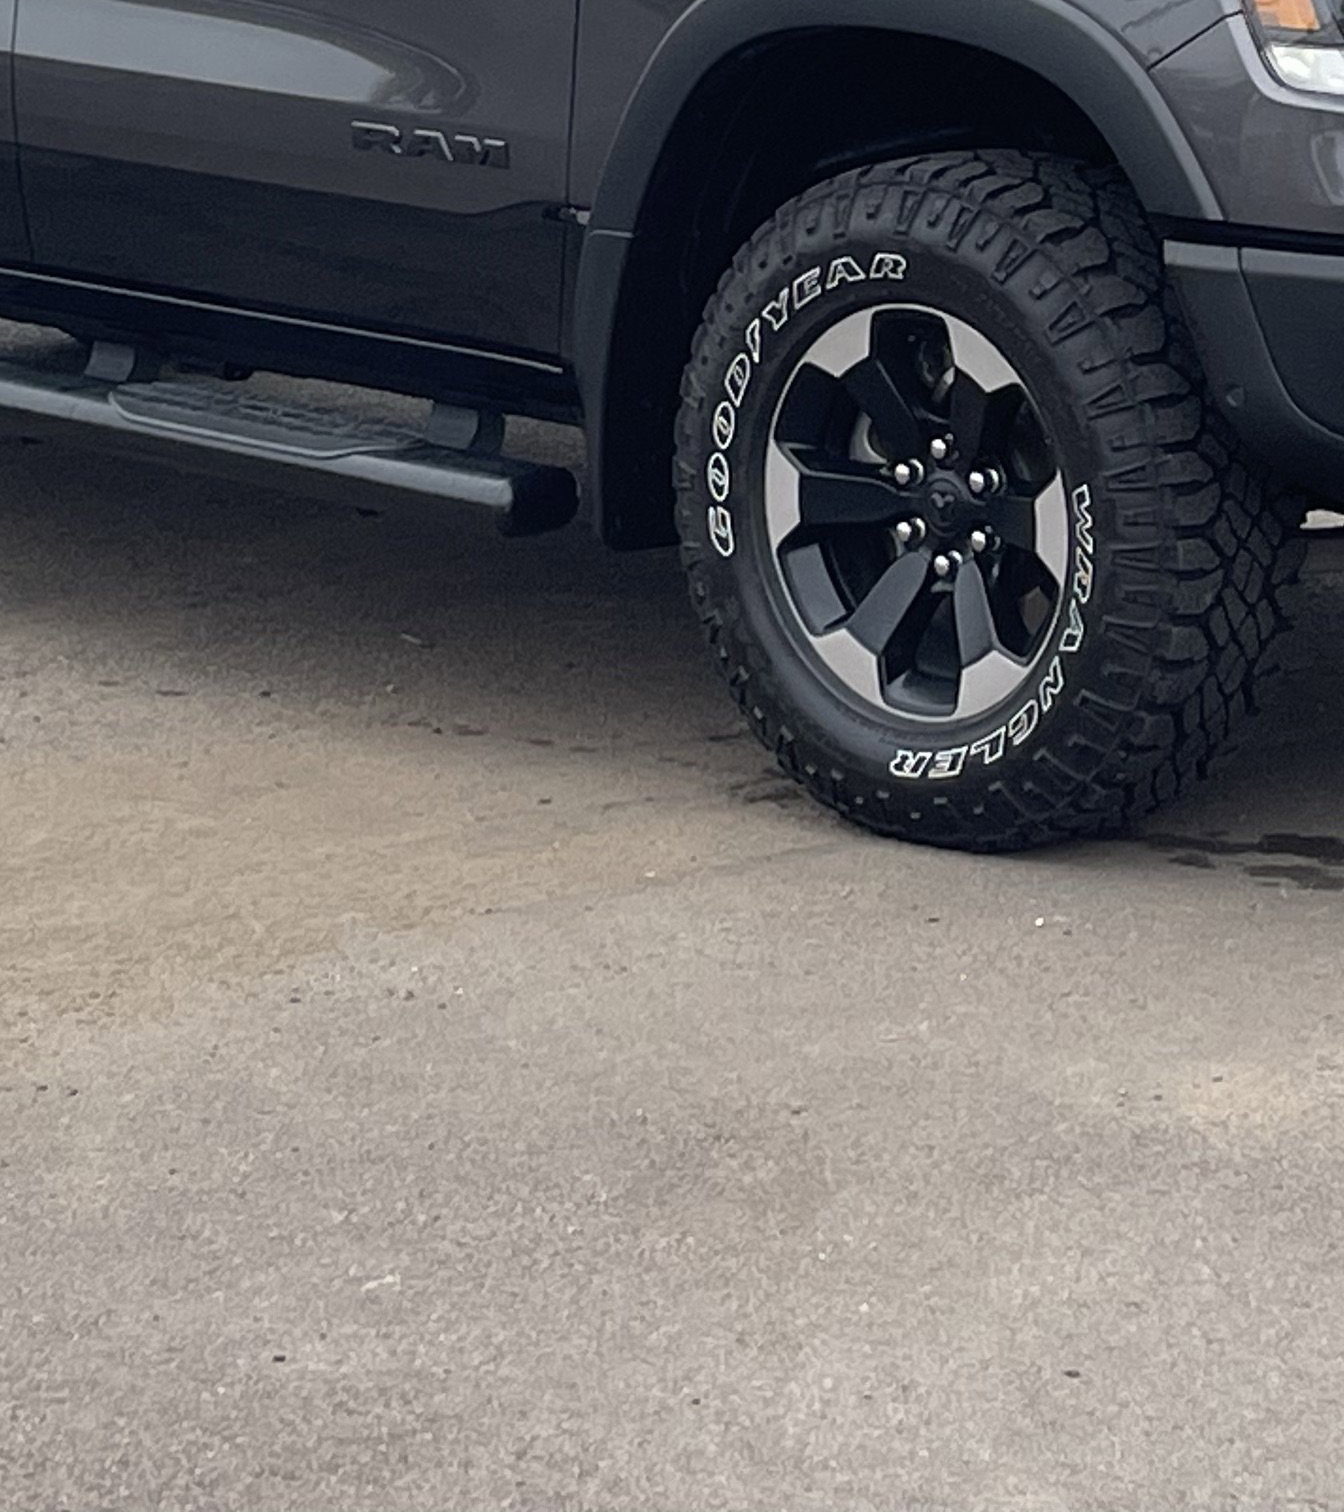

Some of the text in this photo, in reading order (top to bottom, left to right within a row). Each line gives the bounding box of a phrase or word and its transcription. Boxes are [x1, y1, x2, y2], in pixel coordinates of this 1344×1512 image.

[350, 120, 510, 170] RAM
[707, 252, 908, 558] GOODYEAR
[888, 484, 1094, 779] WRANGLER
